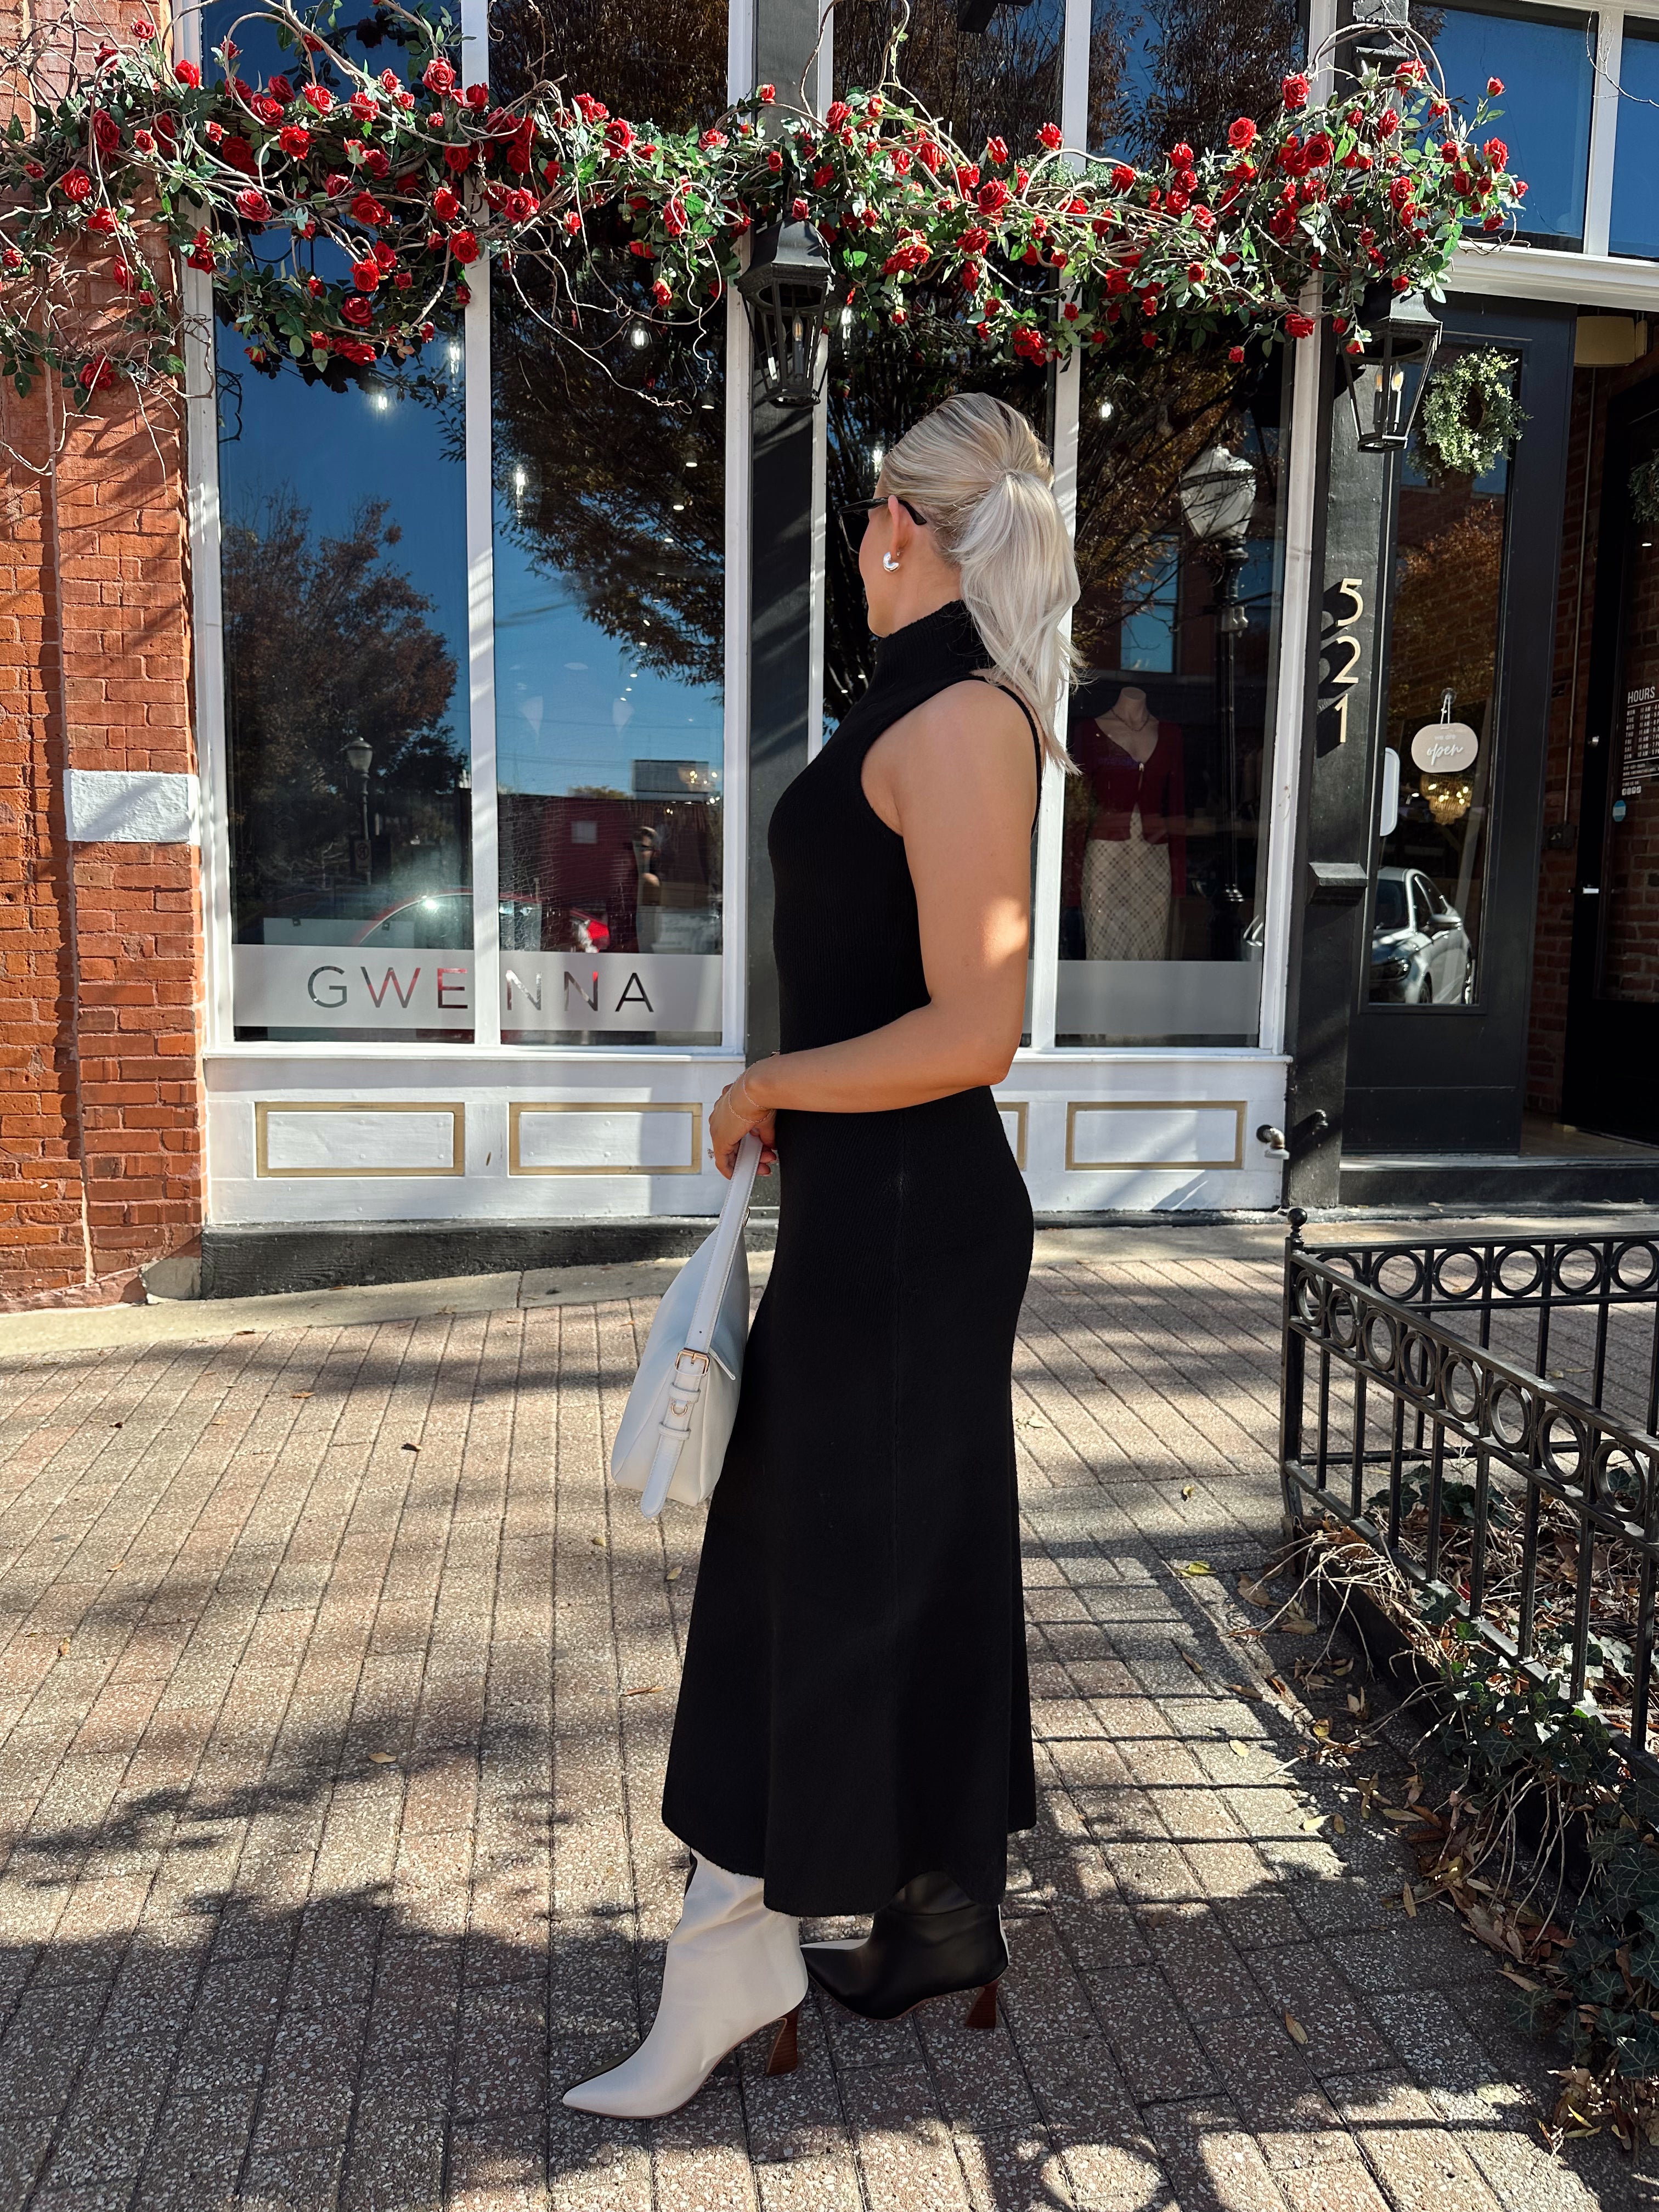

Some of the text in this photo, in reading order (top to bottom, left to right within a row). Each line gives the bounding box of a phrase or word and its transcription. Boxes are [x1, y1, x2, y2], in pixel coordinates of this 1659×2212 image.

[1331, 578, 1363, 743] 521
[1627, 686, 1655, 704] HOURS
[1426, 743, 1464, 766] open
[307, 966, 654, 1013] GWENNA
